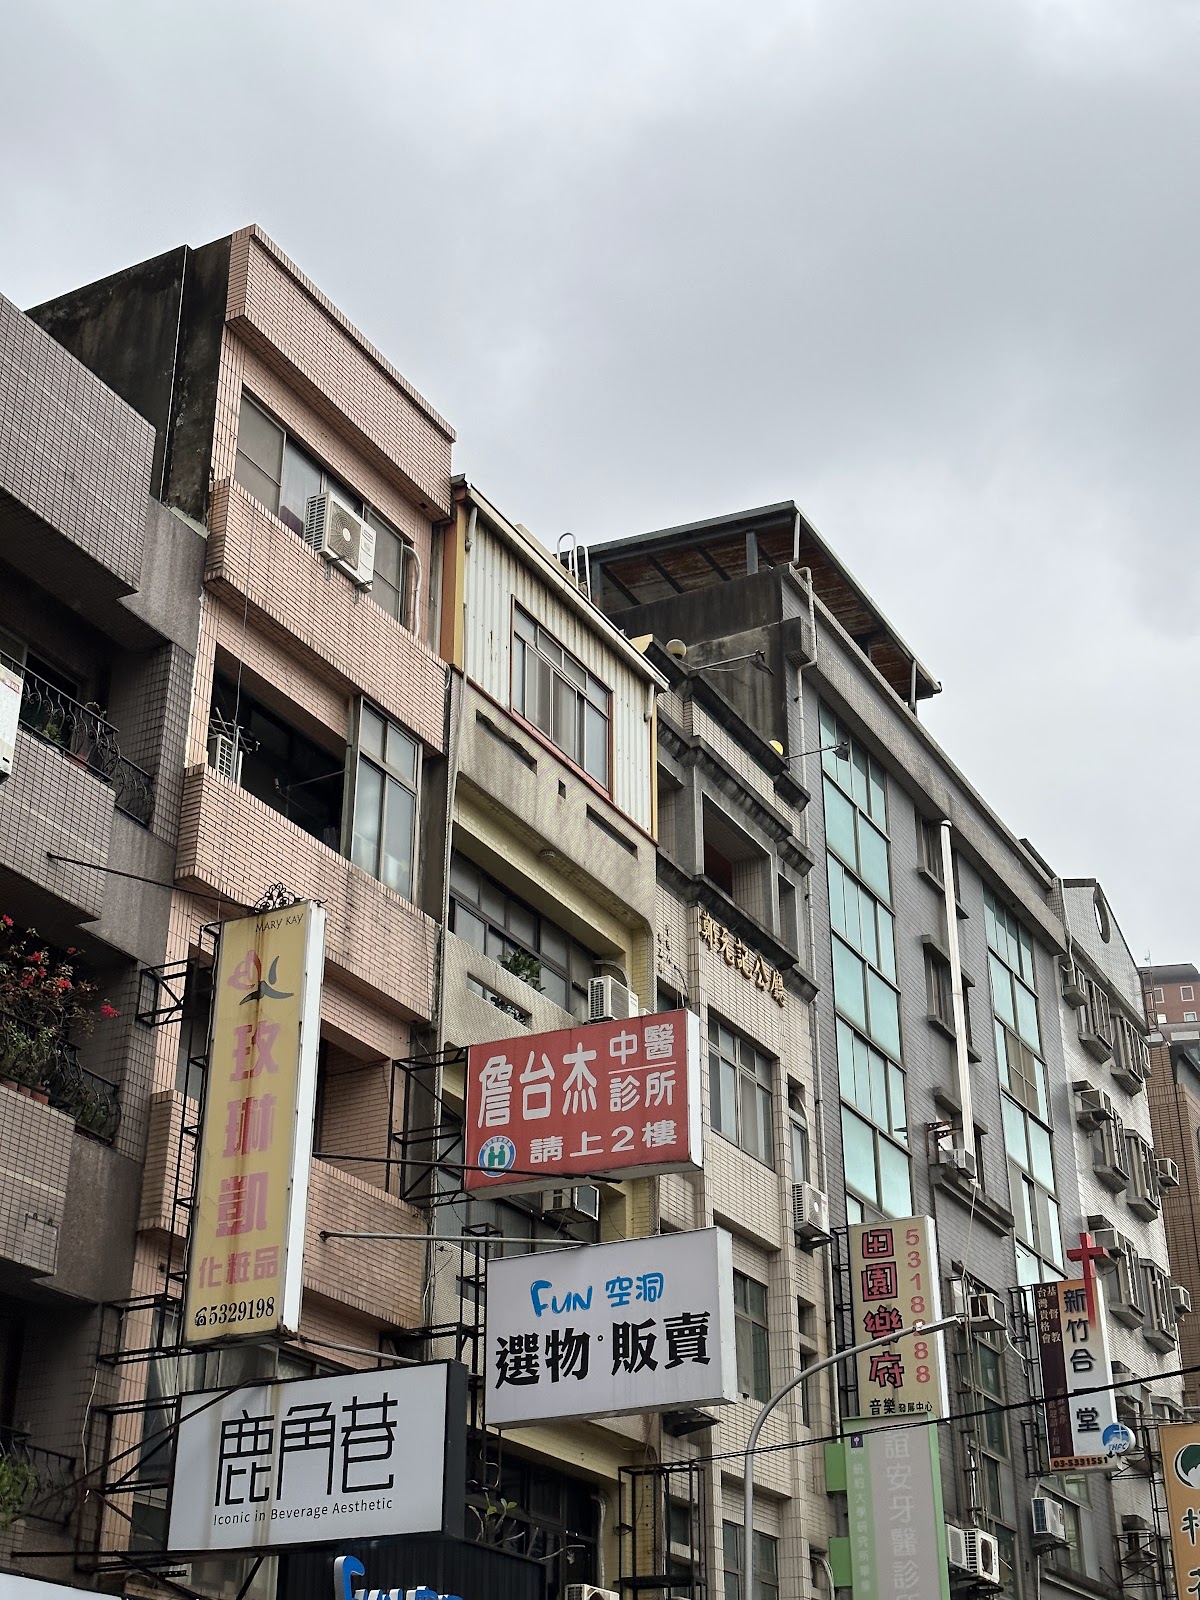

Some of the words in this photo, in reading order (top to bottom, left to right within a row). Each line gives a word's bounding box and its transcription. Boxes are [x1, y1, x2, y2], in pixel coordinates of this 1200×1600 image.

[255, 918, 282, 933] MARY
[285, 913, 304, 926] KAY
[609, 1024, 674, 1065] 中醫
[478, 1042, 597, 1129] 詹台杰
[609, 1070, 676, 1112] 診所
[216, 1021, 281, 1238] 玫琳凱
[530, 1120, 677, 1163] 請上2樓
[199, 1245, 279, 1288] 化粧品
[209, 1296, 275, 1325] 5329198
[605, 1272, 664, 1308] 空洞
[861, 1228, 905, 1388] 田園樂府
[214, 1391, 398, 1506] 鹿角巷
[1053, 1455, 1108, 1468] 03-5331551
[213, 1510, 251, 1526] Iconic
[254, 1509, 266, 1522] in
[271, 1504, 328, 1520] Beverage
[332, 1497, 393, 1515] Aesthetic
[883, 1431, 930, 1600] 誼安牙醫診
